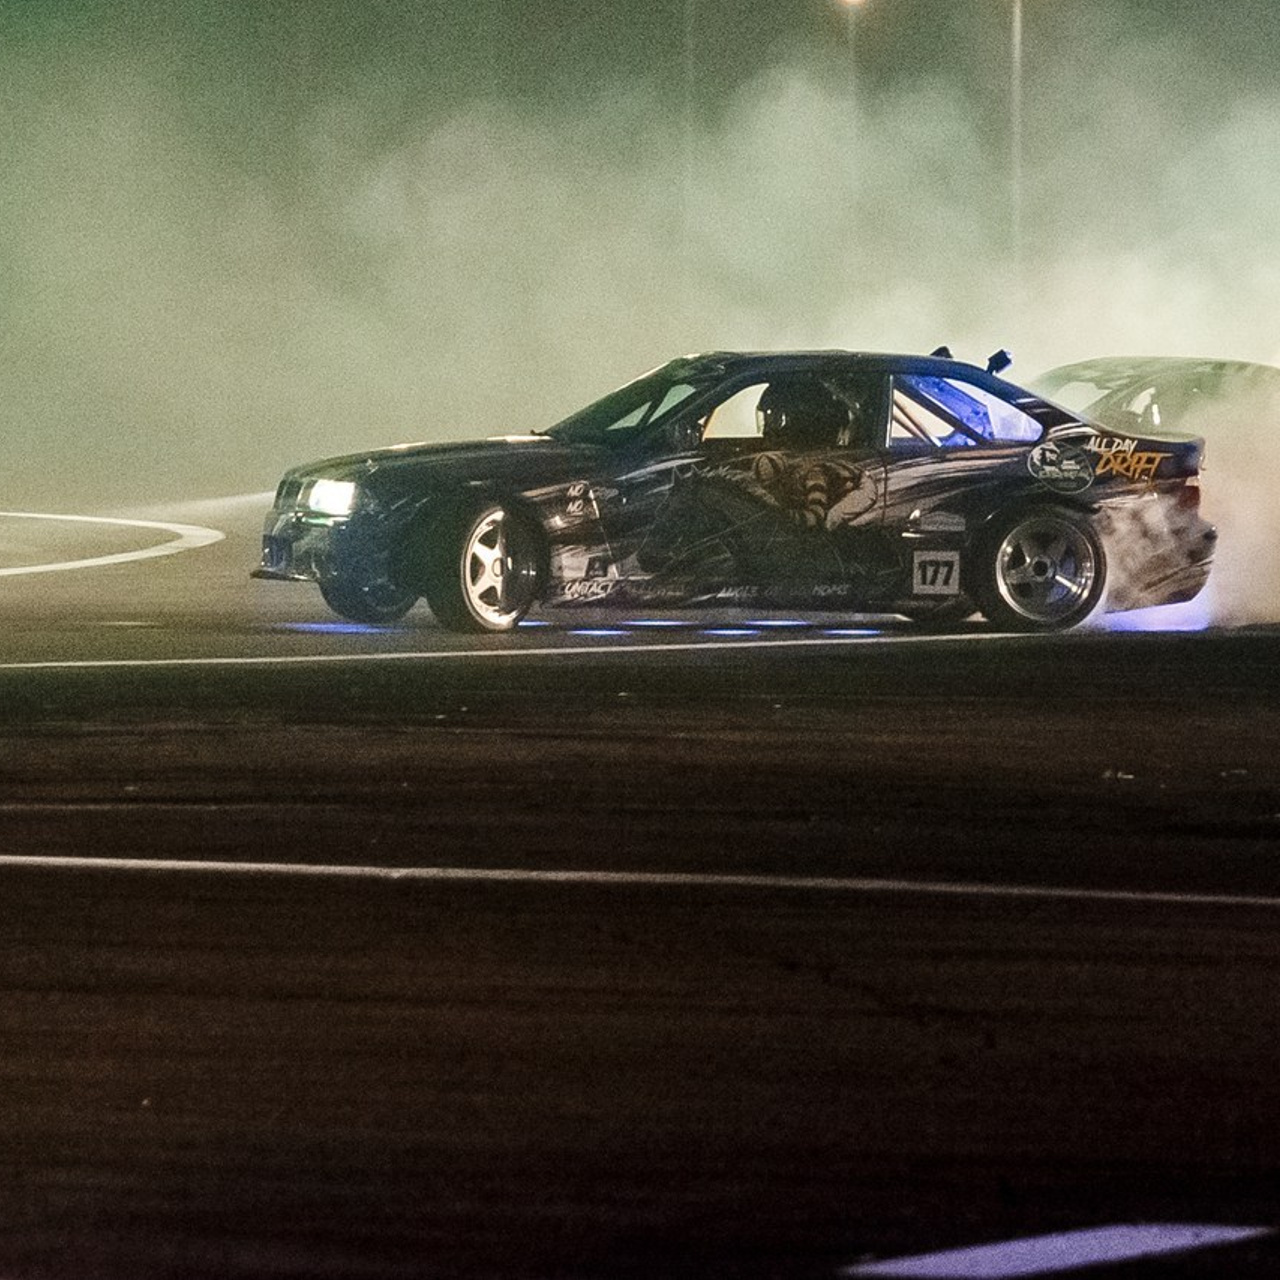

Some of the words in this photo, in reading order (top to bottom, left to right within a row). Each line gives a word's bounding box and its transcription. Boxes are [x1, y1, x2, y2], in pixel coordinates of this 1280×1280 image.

[1084, 435, 1111, 453] ALL
[1111, 436, 1139, 456] DAY
[1095, 451, 1174, 484] DRIFT
[919, 561, 955, 586] 177
